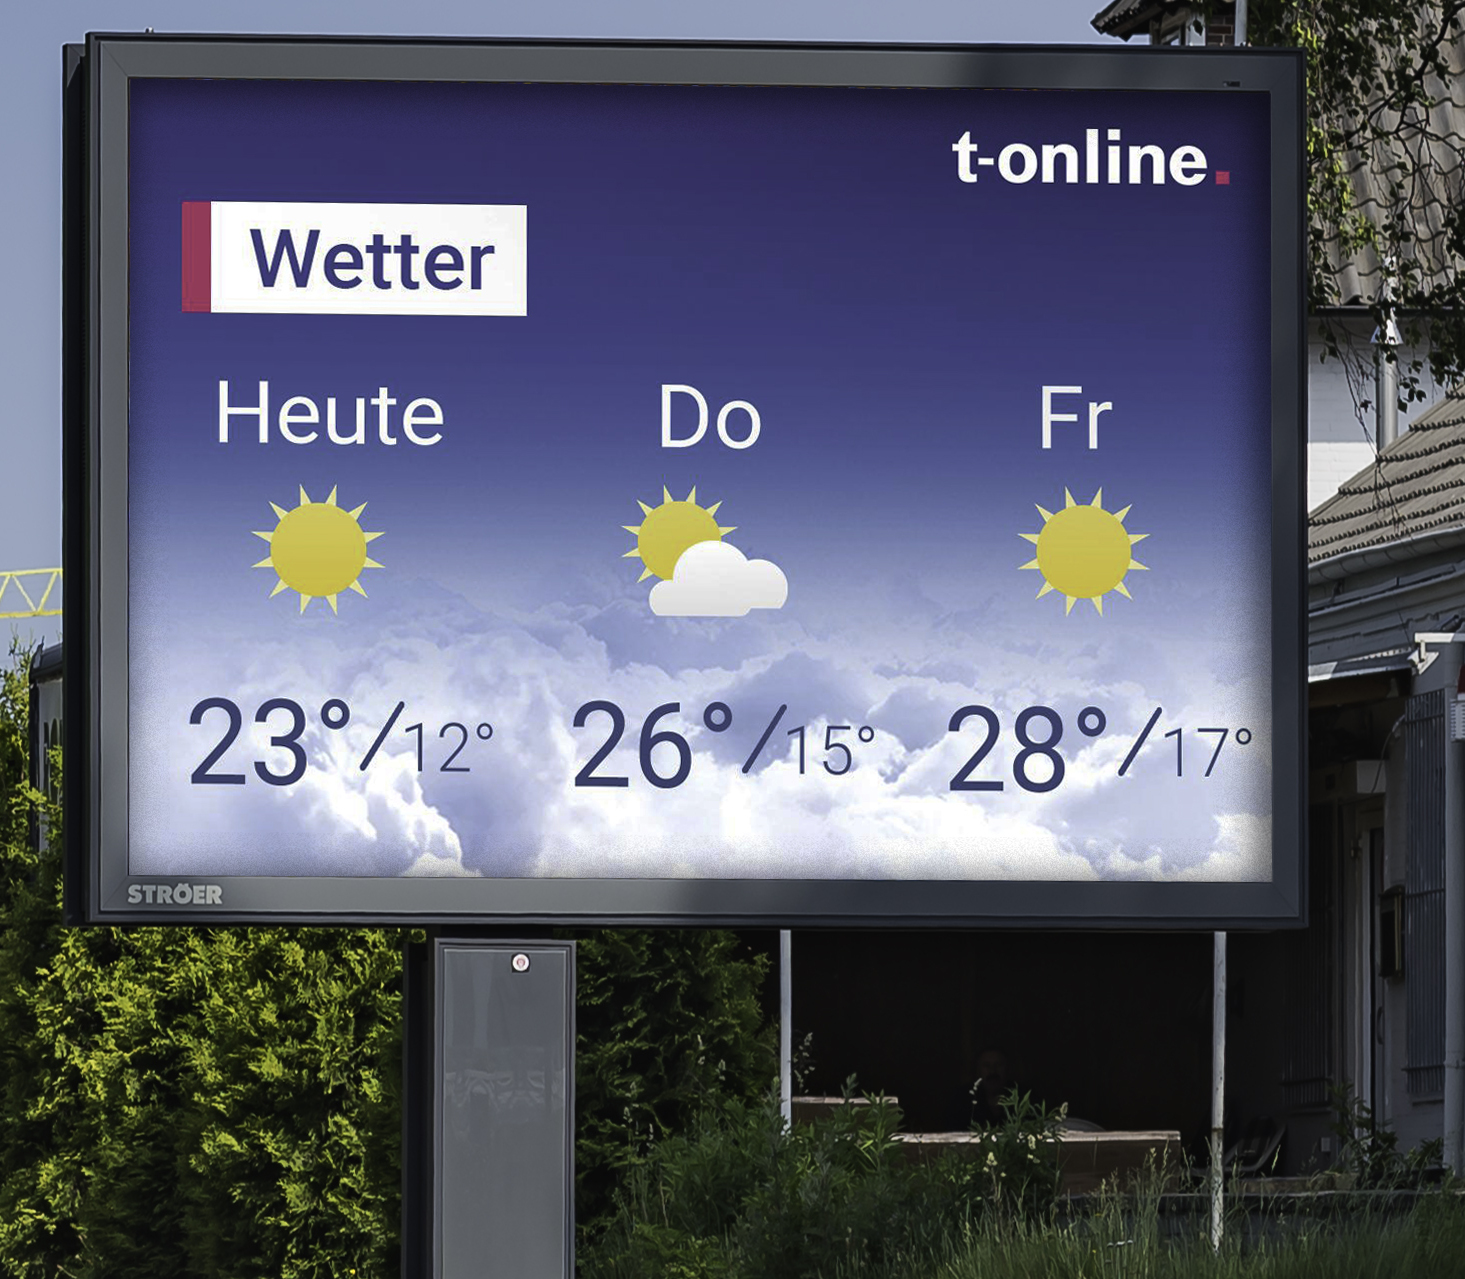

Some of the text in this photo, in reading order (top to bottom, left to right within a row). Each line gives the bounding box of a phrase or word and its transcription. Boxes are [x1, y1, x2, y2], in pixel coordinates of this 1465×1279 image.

[249, 227, 495, 291] Wetter
[216, 380, 1113, 452] Heute Do Fr
[127, 882, 223, 905] STRÖER
